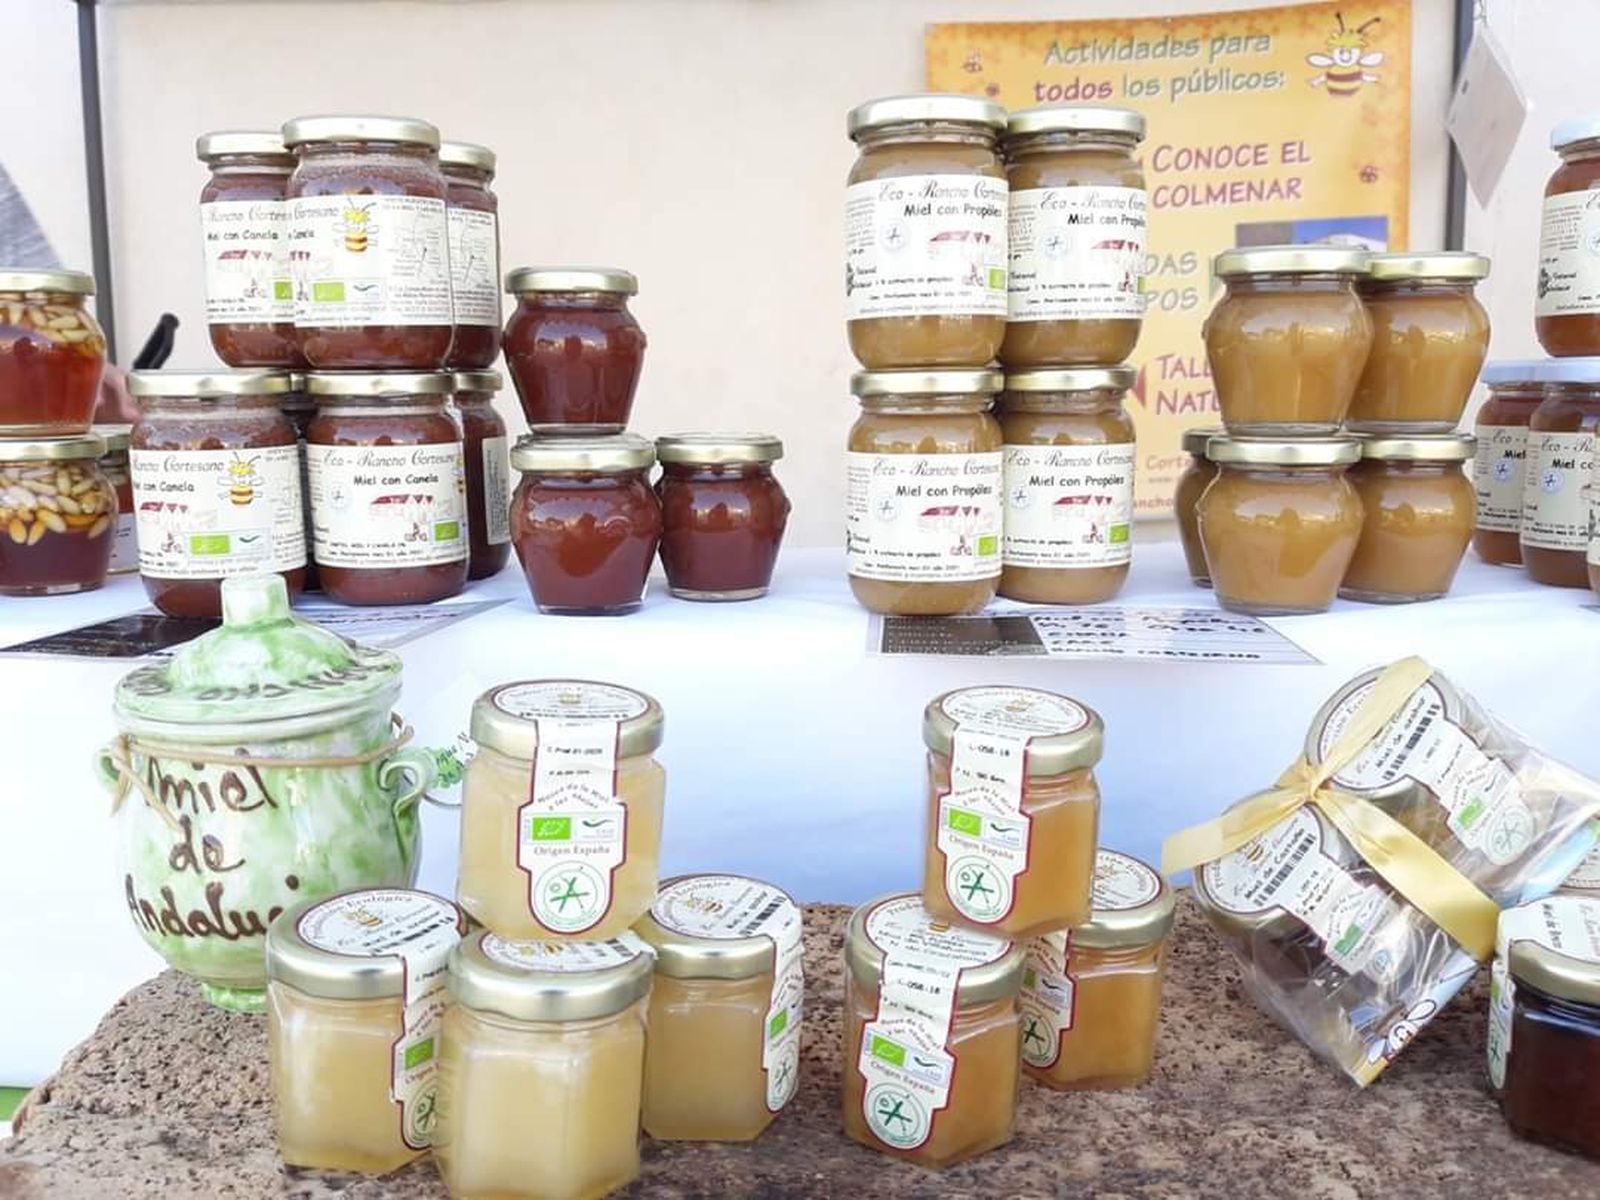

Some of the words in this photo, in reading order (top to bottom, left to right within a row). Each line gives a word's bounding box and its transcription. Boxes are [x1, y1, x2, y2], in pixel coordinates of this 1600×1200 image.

[1044, 35, 1200, 67] Actividades
[1209, 33, 1272, 64] para
[1035, 80, 1114, 102] todos
[1122, 73, 1161, 97] los
[1171, 68, 1286, 103] públicos:
[1153, 140, 1269, 173] CONOCE
[1280, 140, 1312, 165] EL
[1153, 178, 1302, 209] COLMENAR
[903, 203, 932, 217] Miel
[936, 204, 960, 215] con
[1067, 213, 1095, 226] Miel
[1100, 215, 1118, 226] con
[1503, 449, 1527, 461] Miel
[164, 455, 226, 473] Cortesano
[1551, 458, 1575, 470] Miel
[160, 480, 195, 493] Canela
[353, 474, 377, 487] Miel
[381, 475, 401, 486] con
[405, 474, 439, 486] Canela
[1028, 475, 1055, 488] Miel
[1059, 477, 1081, 488] con
[895, 485, 921, 498] Miel
[926, 486, 949, 497] con
[169, 814, 247, 875] de
[534, 845, 571, 858] Origen
[573, 845, 611, 858] España
[949, 834, 980, 851] Origen
[981, 844, 1015, 861] España
[1244, 879, 1263, 900] Miel
[1262, 866, 1274, 880] de
